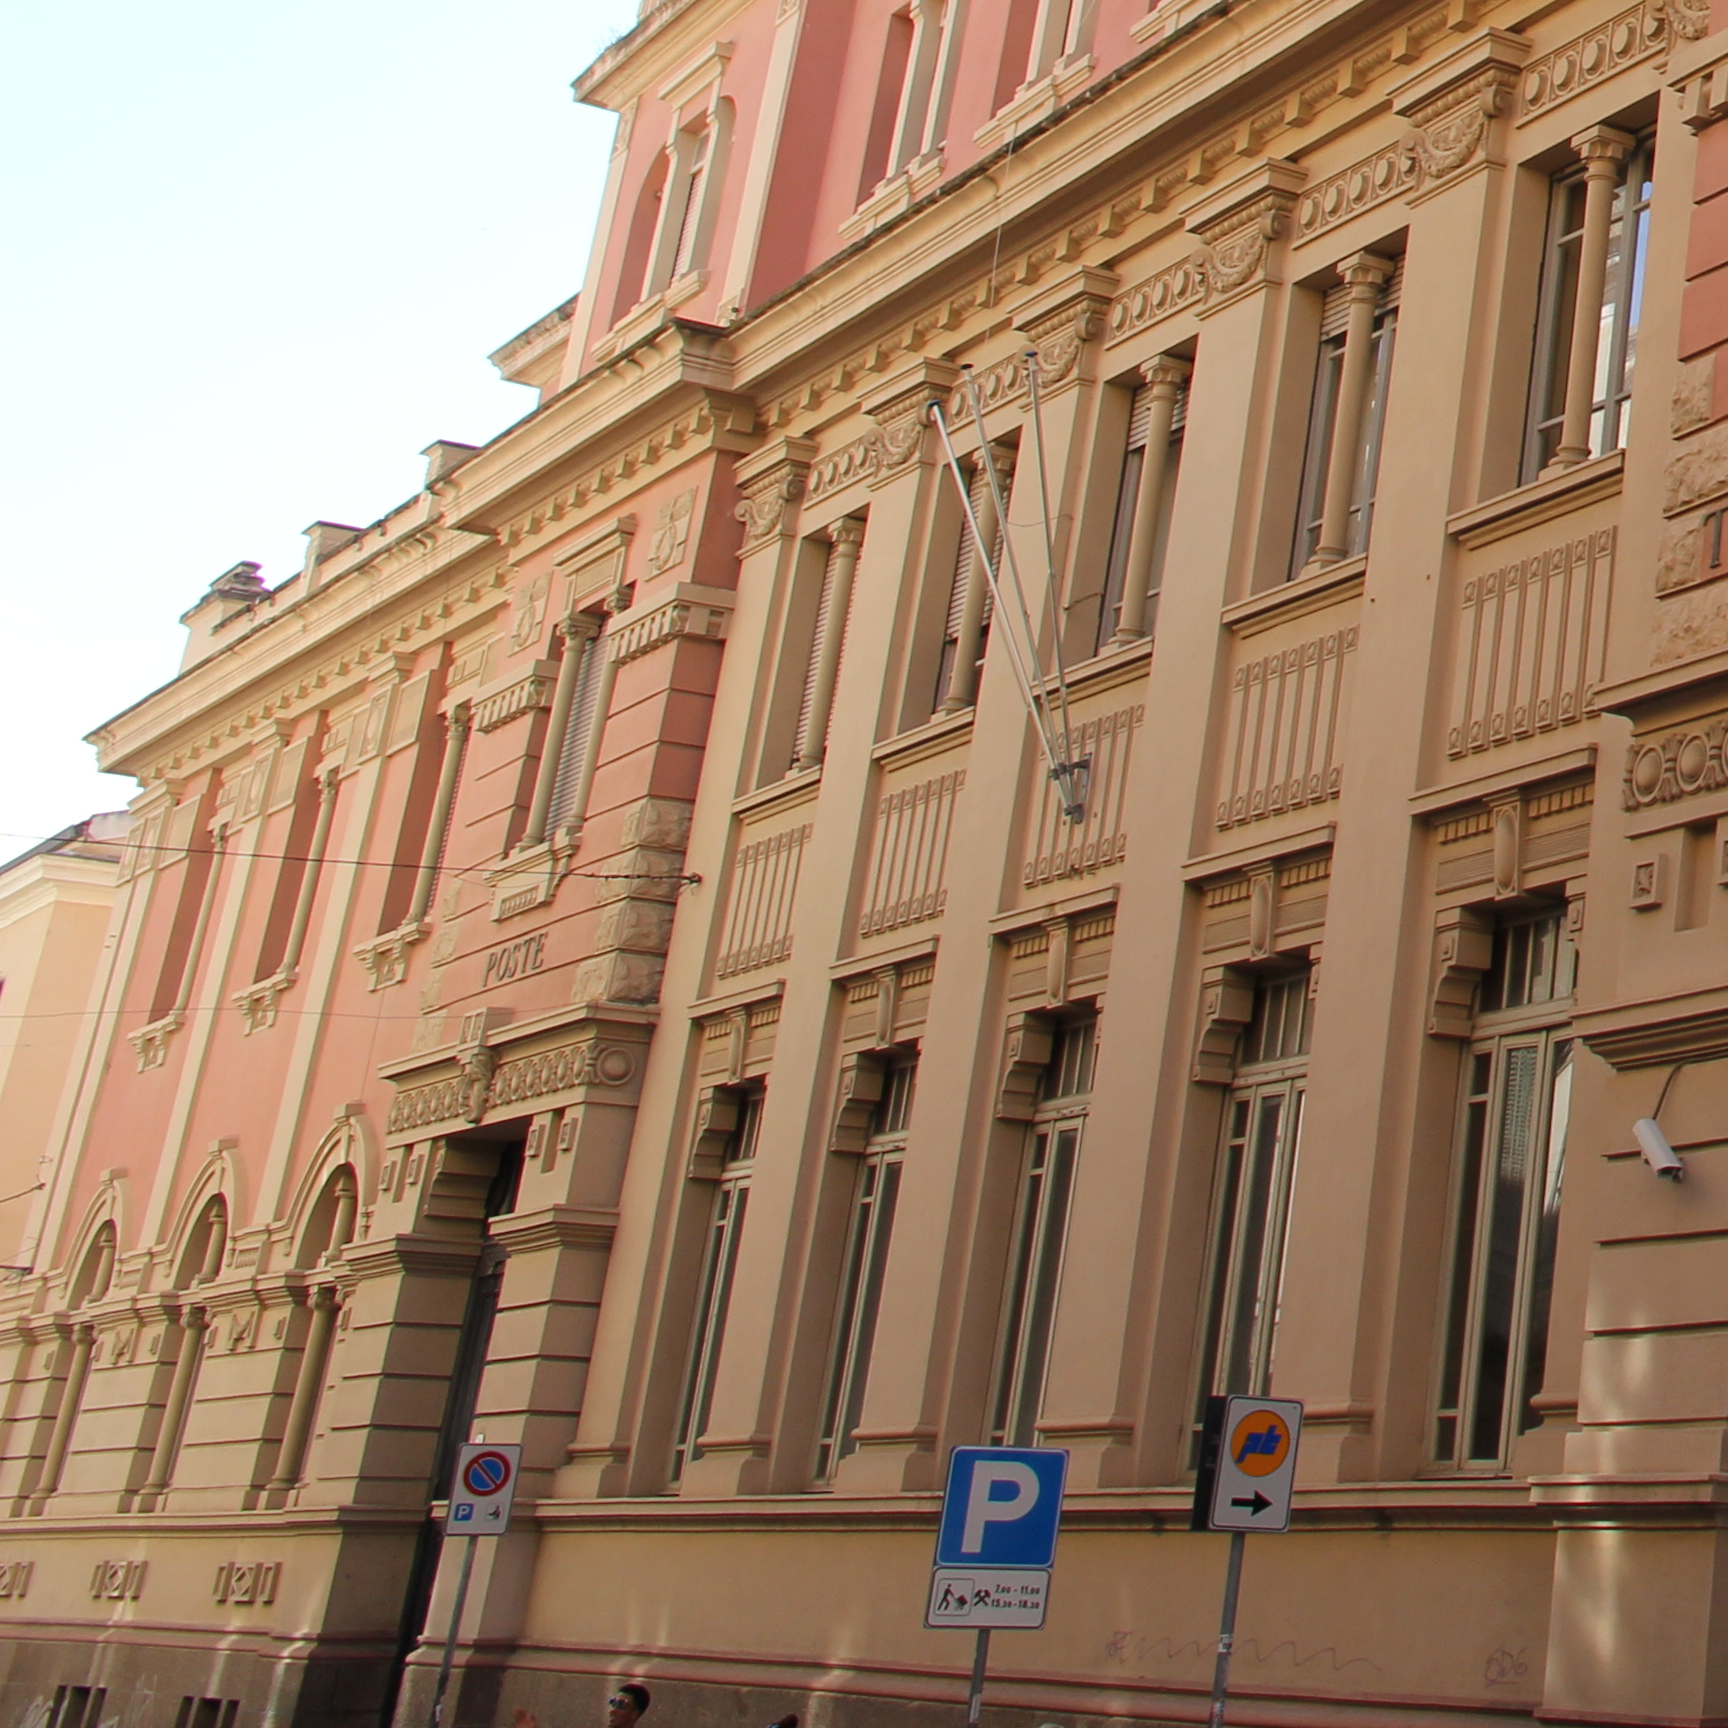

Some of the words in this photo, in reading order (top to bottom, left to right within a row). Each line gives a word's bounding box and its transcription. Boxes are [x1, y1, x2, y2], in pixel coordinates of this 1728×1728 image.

[483, 930, 549, 988] POSTE
[458, 1506, 471, 1519] P
[961, 1459, 1041, 1554] P
